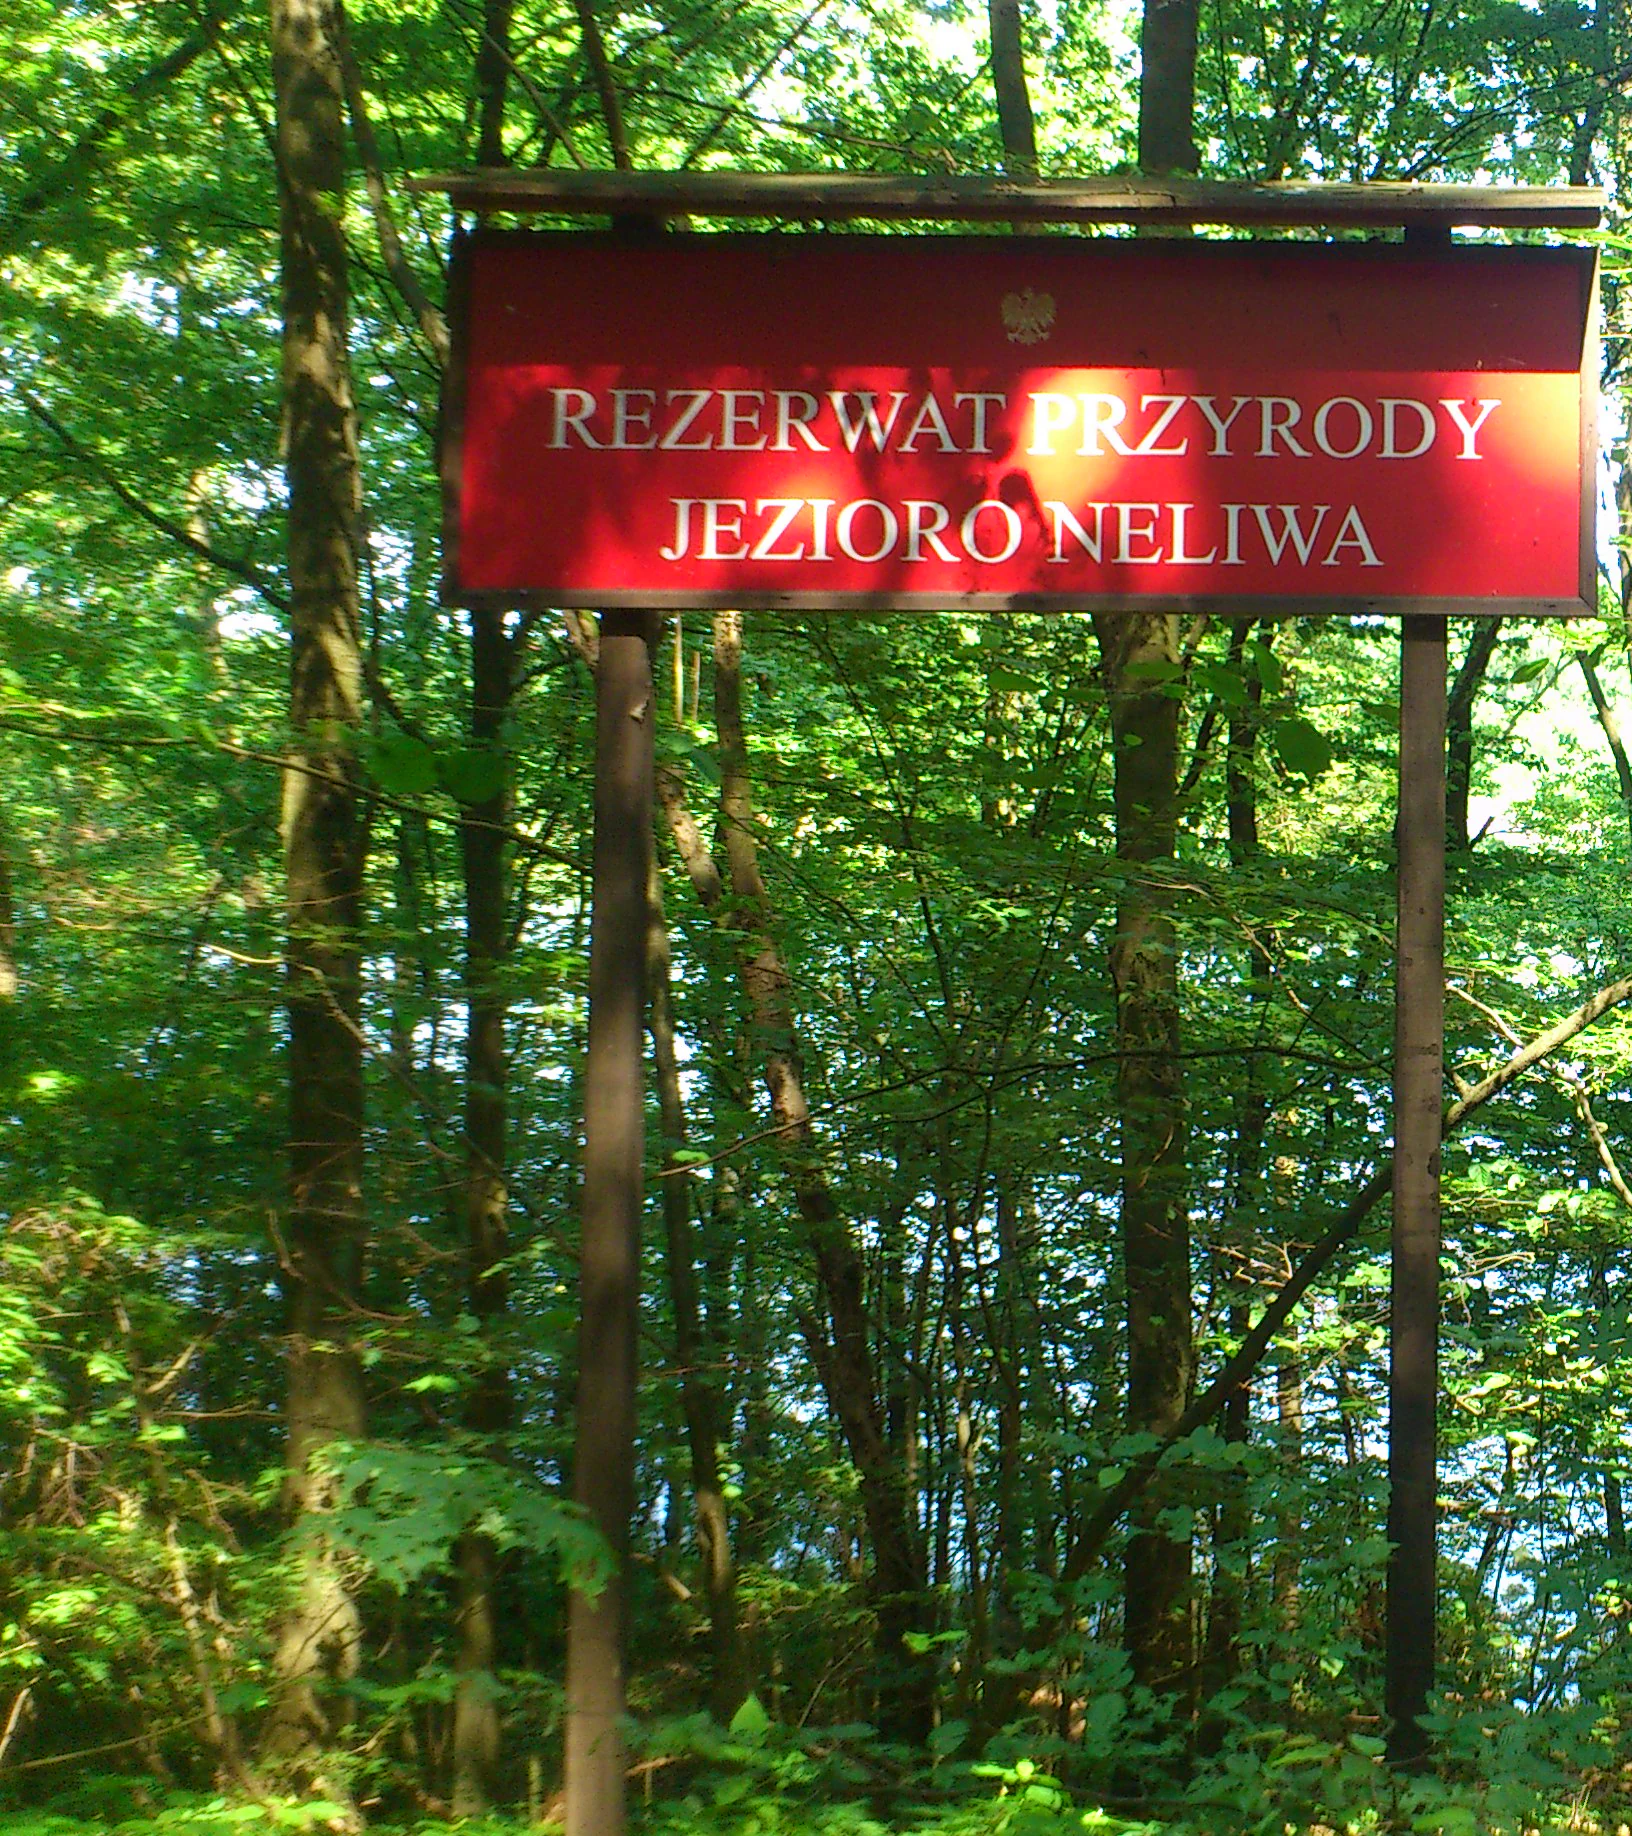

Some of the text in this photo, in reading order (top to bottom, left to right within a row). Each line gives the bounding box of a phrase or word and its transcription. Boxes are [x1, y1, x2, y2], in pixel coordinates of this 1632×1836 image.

[547, 387, 1502, 460] REZERWAT PRZYRODY
[660, 499, 1384, 567] JEZIORO NELIWA
